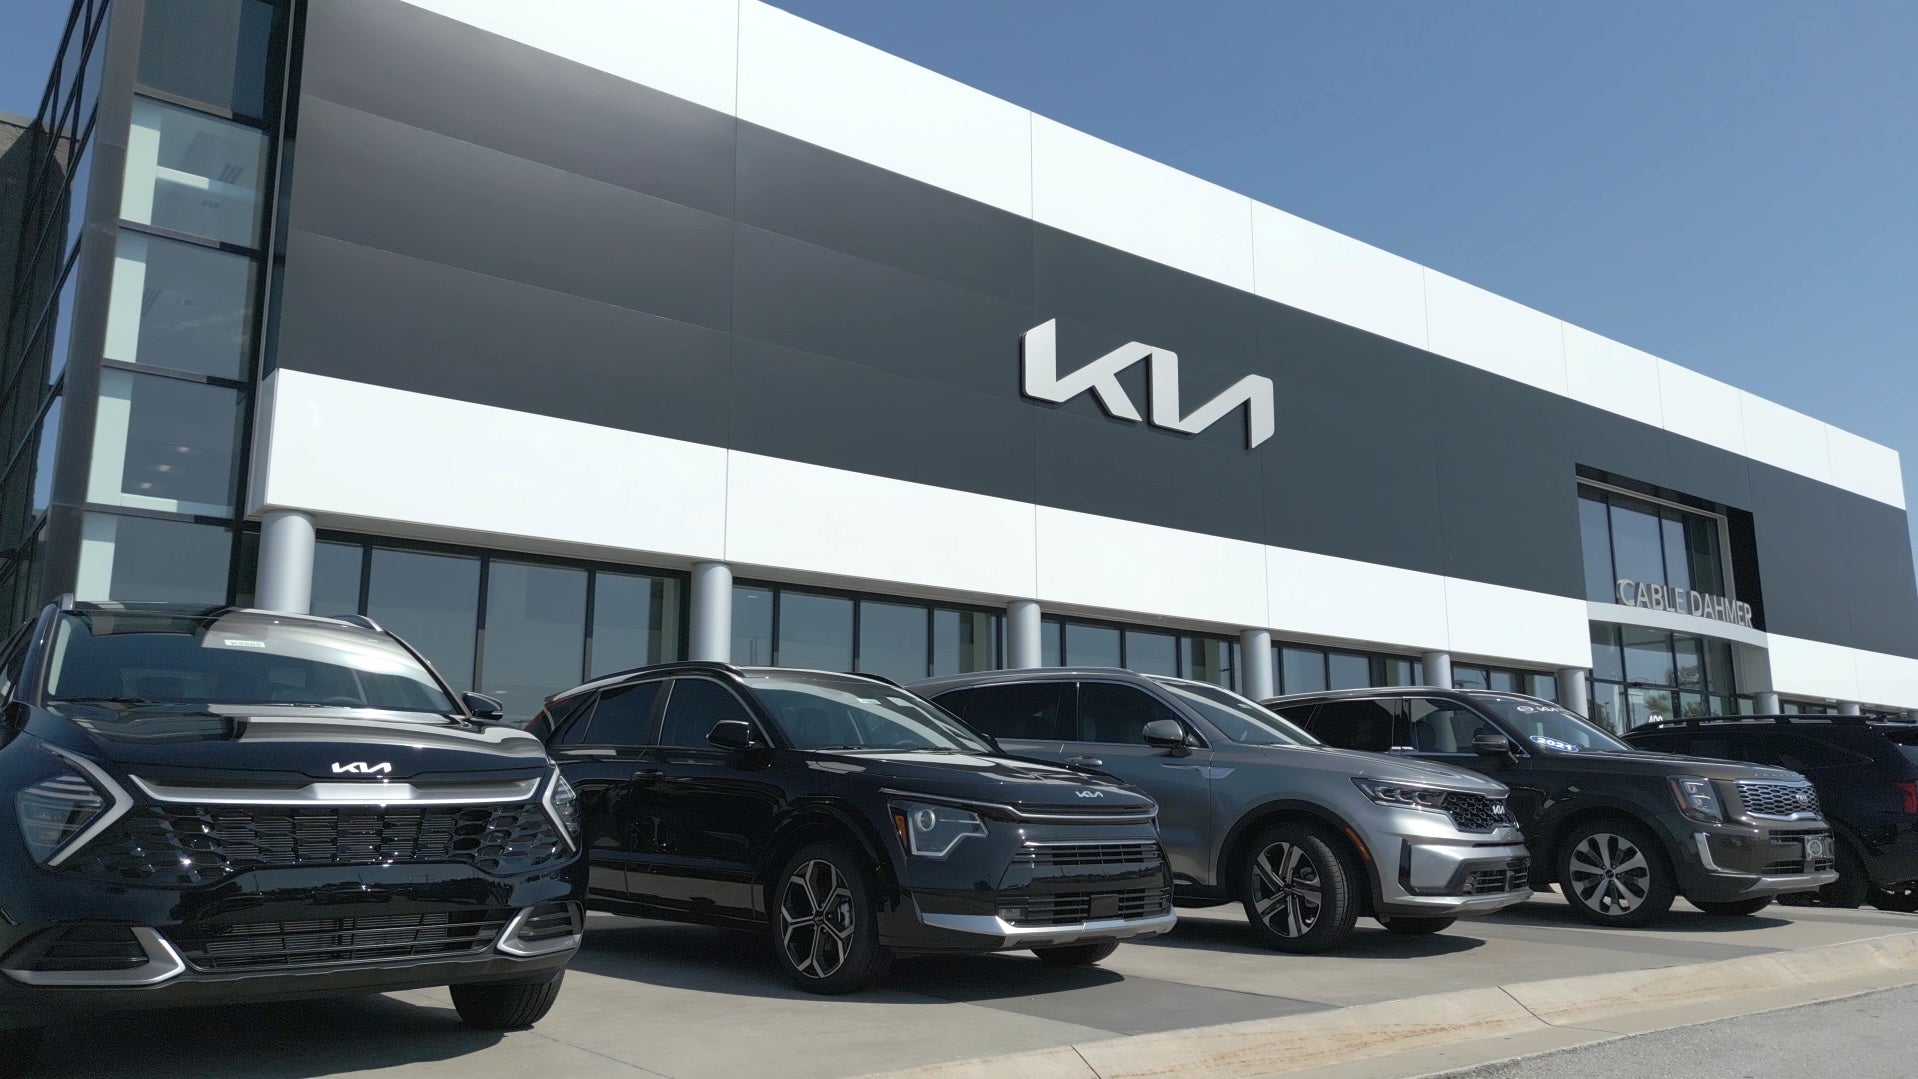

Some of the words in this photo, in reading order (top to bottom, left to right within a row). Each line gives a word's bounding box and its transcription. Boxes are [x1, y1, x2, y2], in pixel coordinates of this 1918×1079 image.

[1021, 317, 1275, 449] KIA
[1616, 578, 1687, 615] CABLE
[1689, 590, 1753, 629] DAHMER
[1536, 737, 1573, 751] 2021
